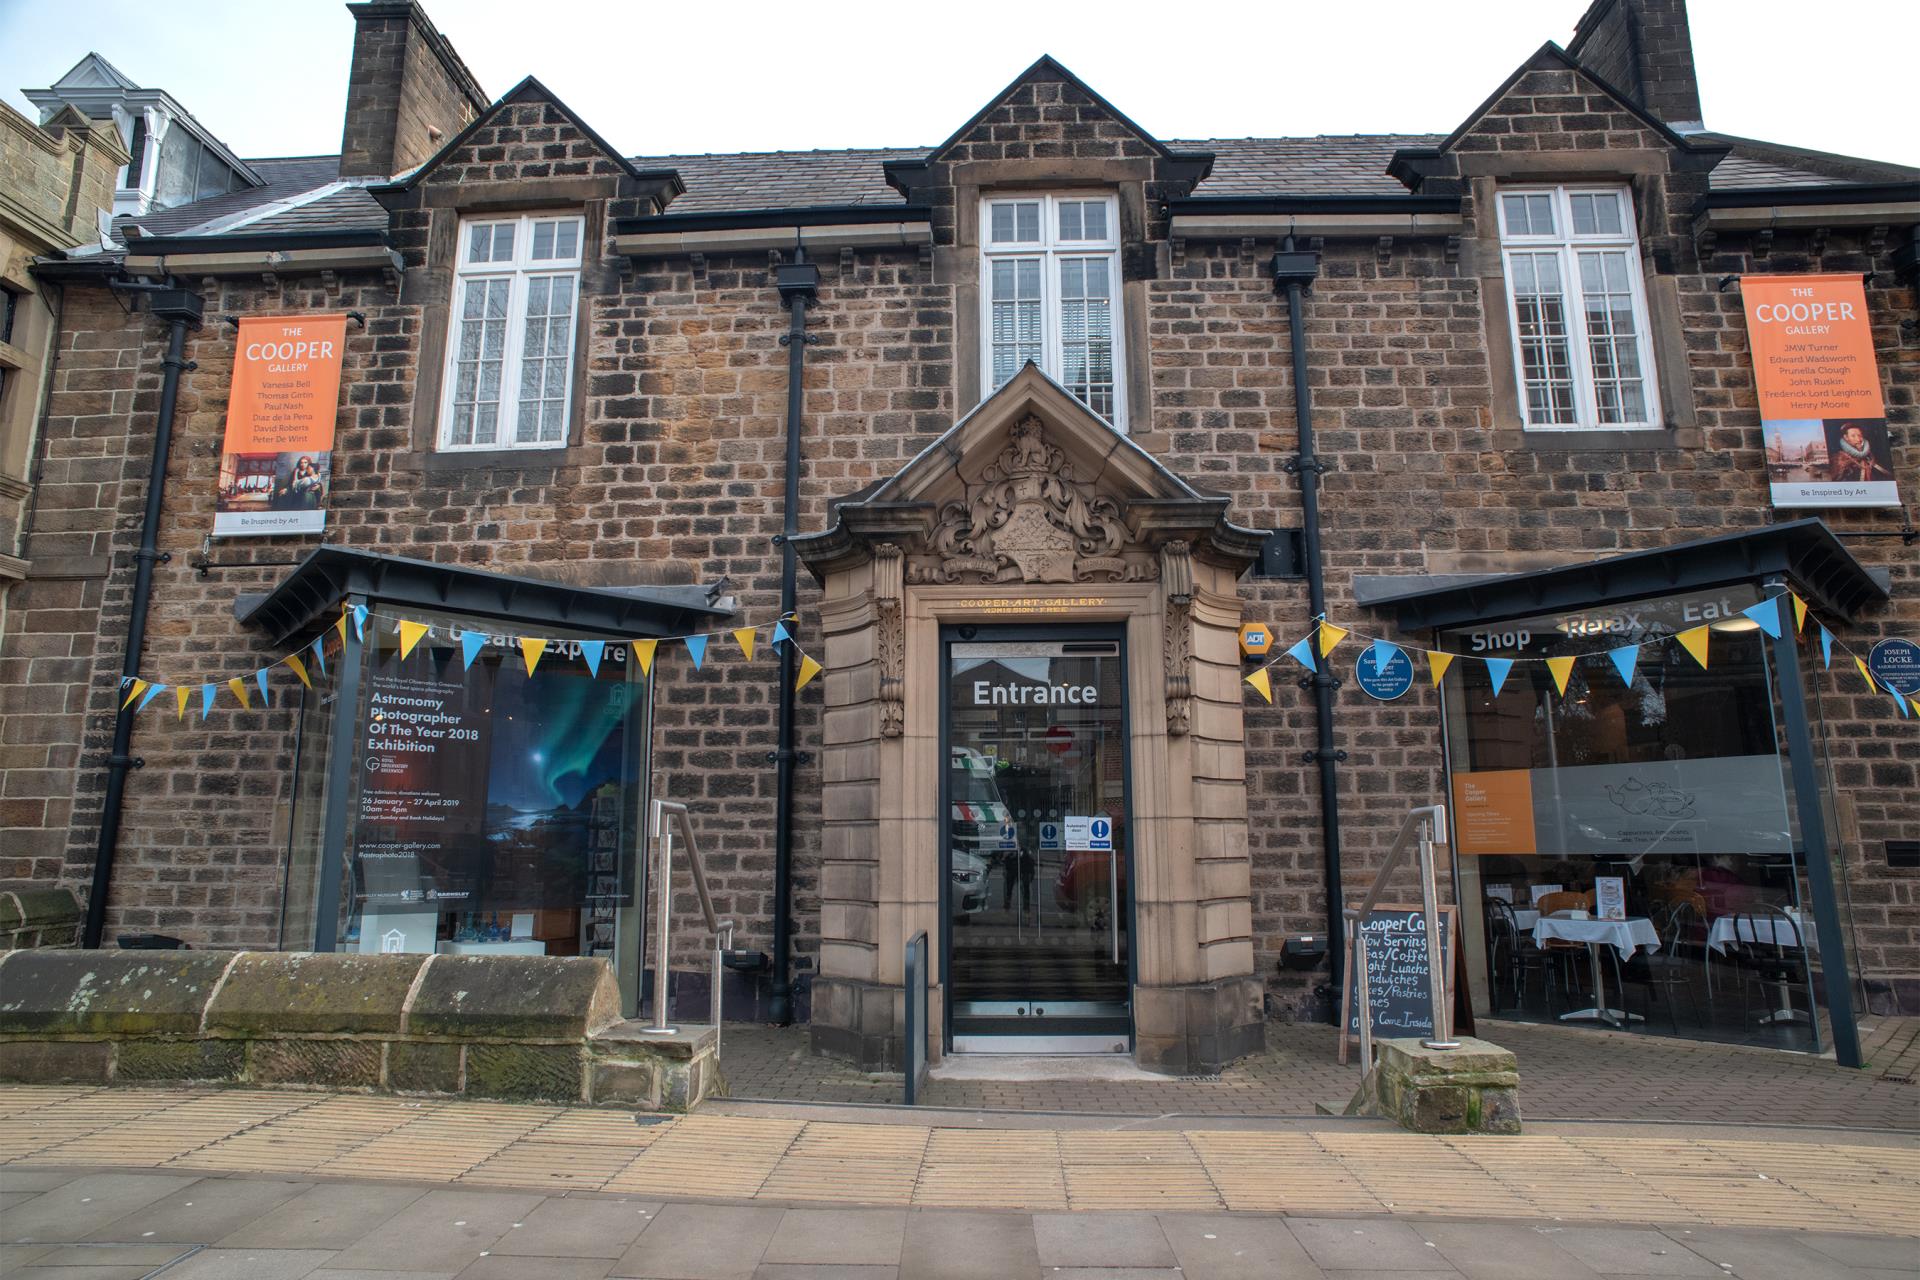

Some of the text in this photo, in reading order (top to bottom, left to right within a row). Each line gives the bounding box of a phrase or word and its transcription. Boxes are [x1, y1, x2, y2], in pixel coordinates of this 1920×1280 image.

[1790, 287, 1814, 297] THE
[1756, 302, 1856, 323] COOPER
[282, 327, 303, 336] THE
[1785, 325, 1830, 335] GALLERY
[246, 341, 333, 360] COOPER
[1784, 343, 1838, 352] JMW Turner
[1769, 354, 1857, 364] Edward Wadsworth
[268, 363, 308, 373] GALLERY
[1779, 365, 1851, 375] Prunella Clough
[262, 380, 310, 389] Vanessa Bell
[1789, 376, 1845, 387] John Ruskin
[256, 392, 289, 400] Thomas
[1765, 387, 1872, 399] Frederick Lord Leighton
[264, 402, 304, 410] Paul Nash
[1791, 400, 1850, 411] Henry Moore
[254, 423, 309, 433] David Roberts
[252, 434, 308, 443] Peter De Wint
[1800, 488, 1868, 498] Be Inspired by Art
[241, 518, 251, 526] Be
[251, 517, 278, 527] Inspired
[279, 517, 288, 525] by
[960, 598, 1105, 608] COOPER ART GALLERY
[1471, 596, 1733, 652] Shop Relax Eat
[1247, 634, 1265, 643] ADT
[543, 638, 626, 662] Expre
[974, 681, 1098, 705] Entrance
[371, 692, 444, 711] Astronomy
[370, 707, 461, 725] Photographer
[369, 723, 479, 740] Of The Year 2018
[368, 739, 435, 753] Exhibition
[373, 798, 403, 807] January
[424, 799, 441, 808] April
[362, 805, 382, 813] 10am
[391, 806, 408, 814] 4pm
[359, 841, 441, 851] www.cooper-gallery.com
[1367, 960, 1387, 974] ght
